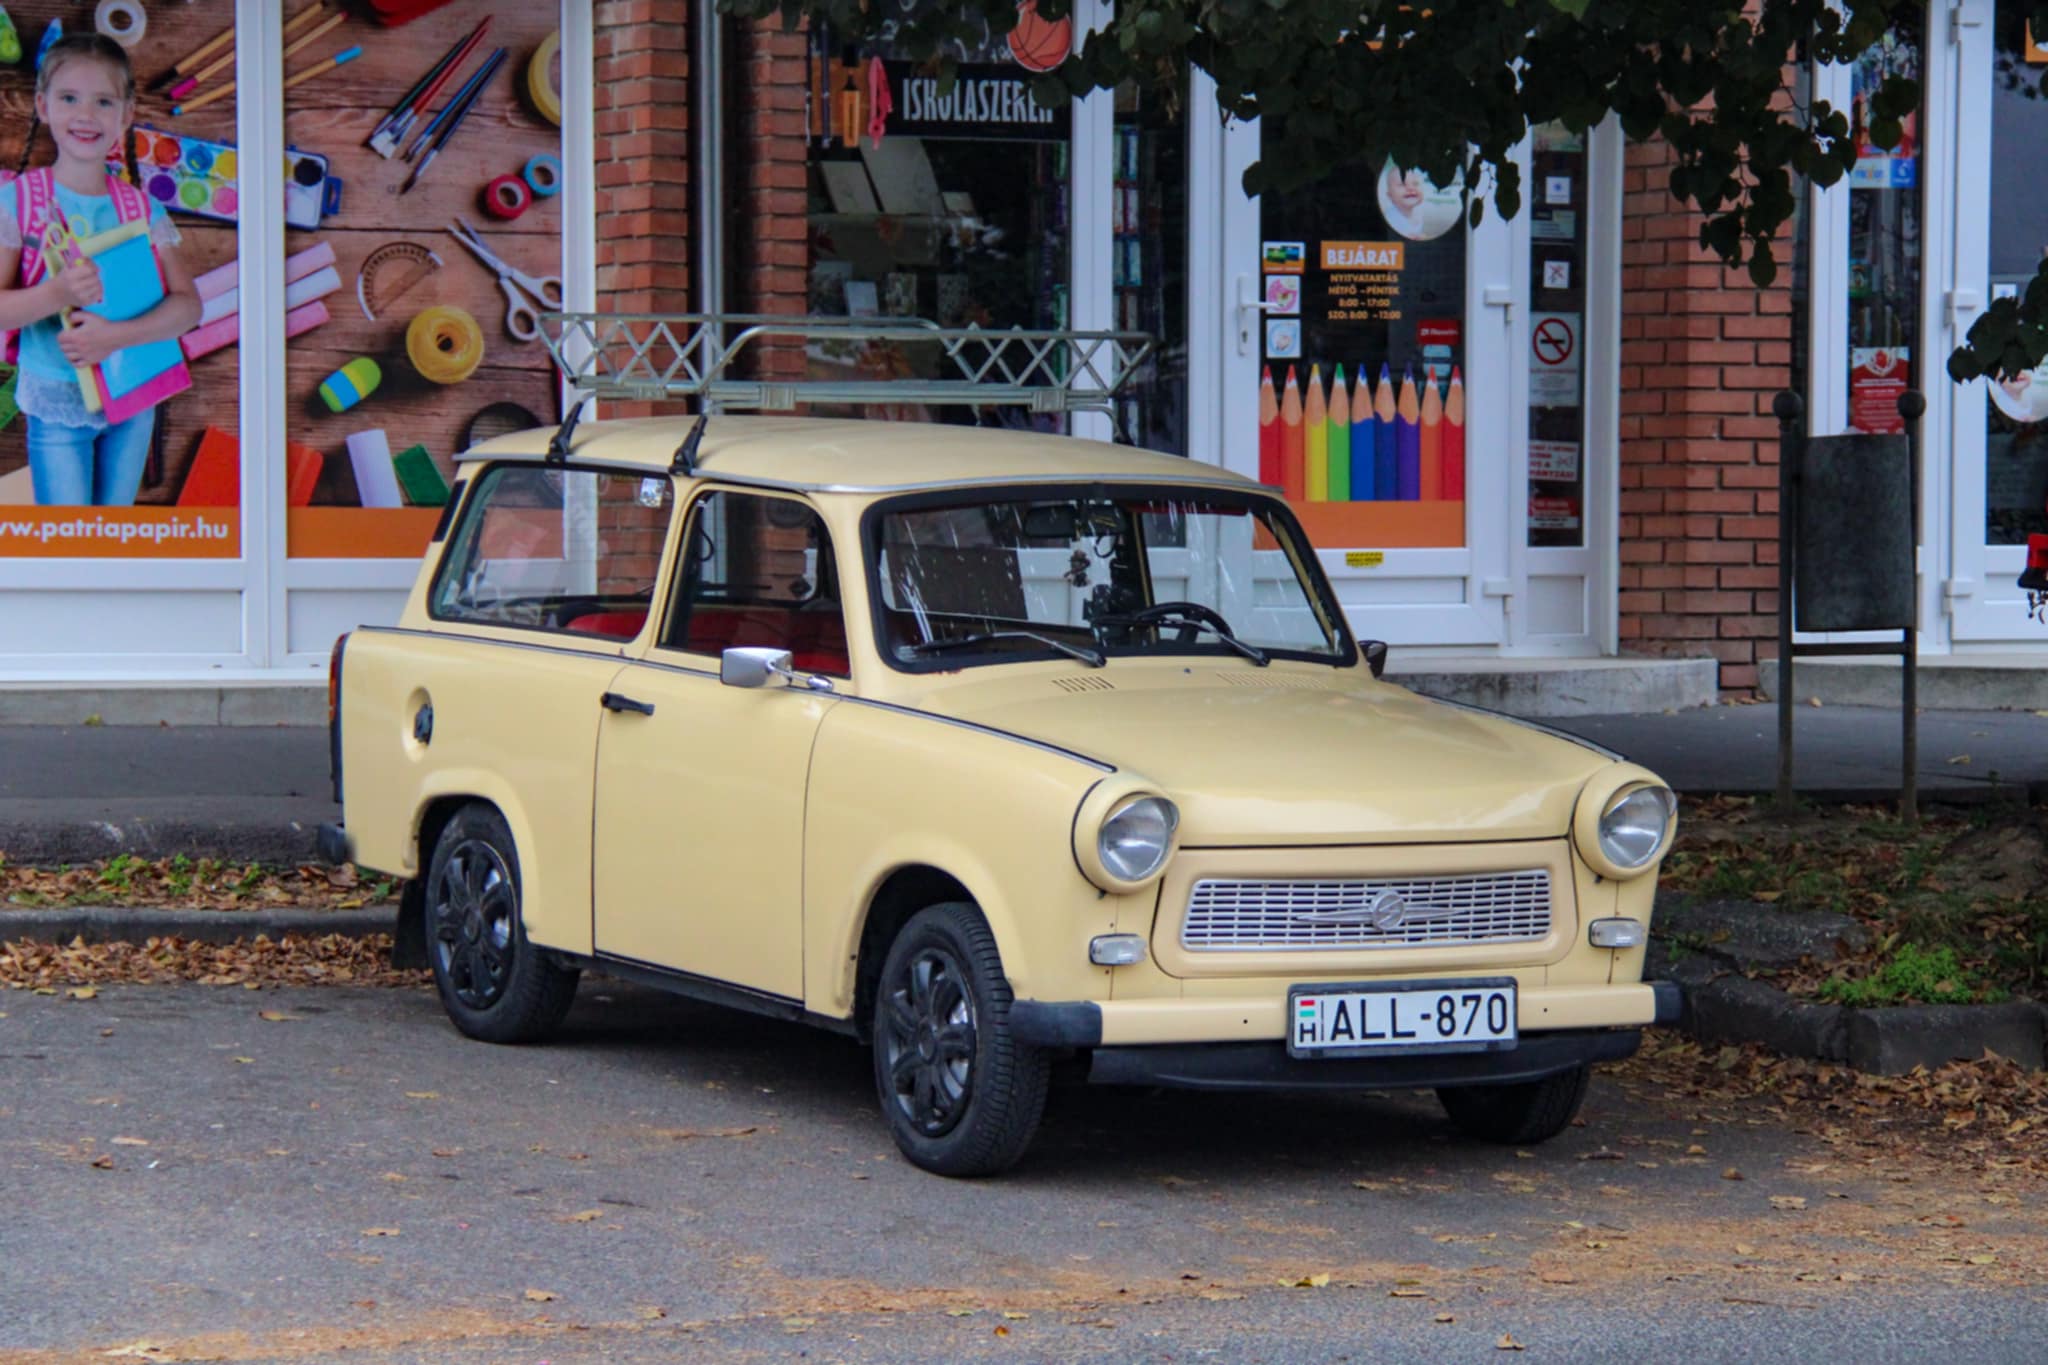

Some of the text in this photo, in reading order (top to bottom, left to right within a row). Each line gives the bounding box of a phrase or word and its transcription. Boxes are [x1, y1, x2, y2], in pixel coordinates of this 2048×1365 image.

[1327, 244, 1398, 266] BEJÁRAT
[1330, 272, 1399, 283] NYITVATARTÁS
[0, 516, 228, 543] w.patriapapir.hu
[1300, 993, 1508, 1043] H ALL-870
